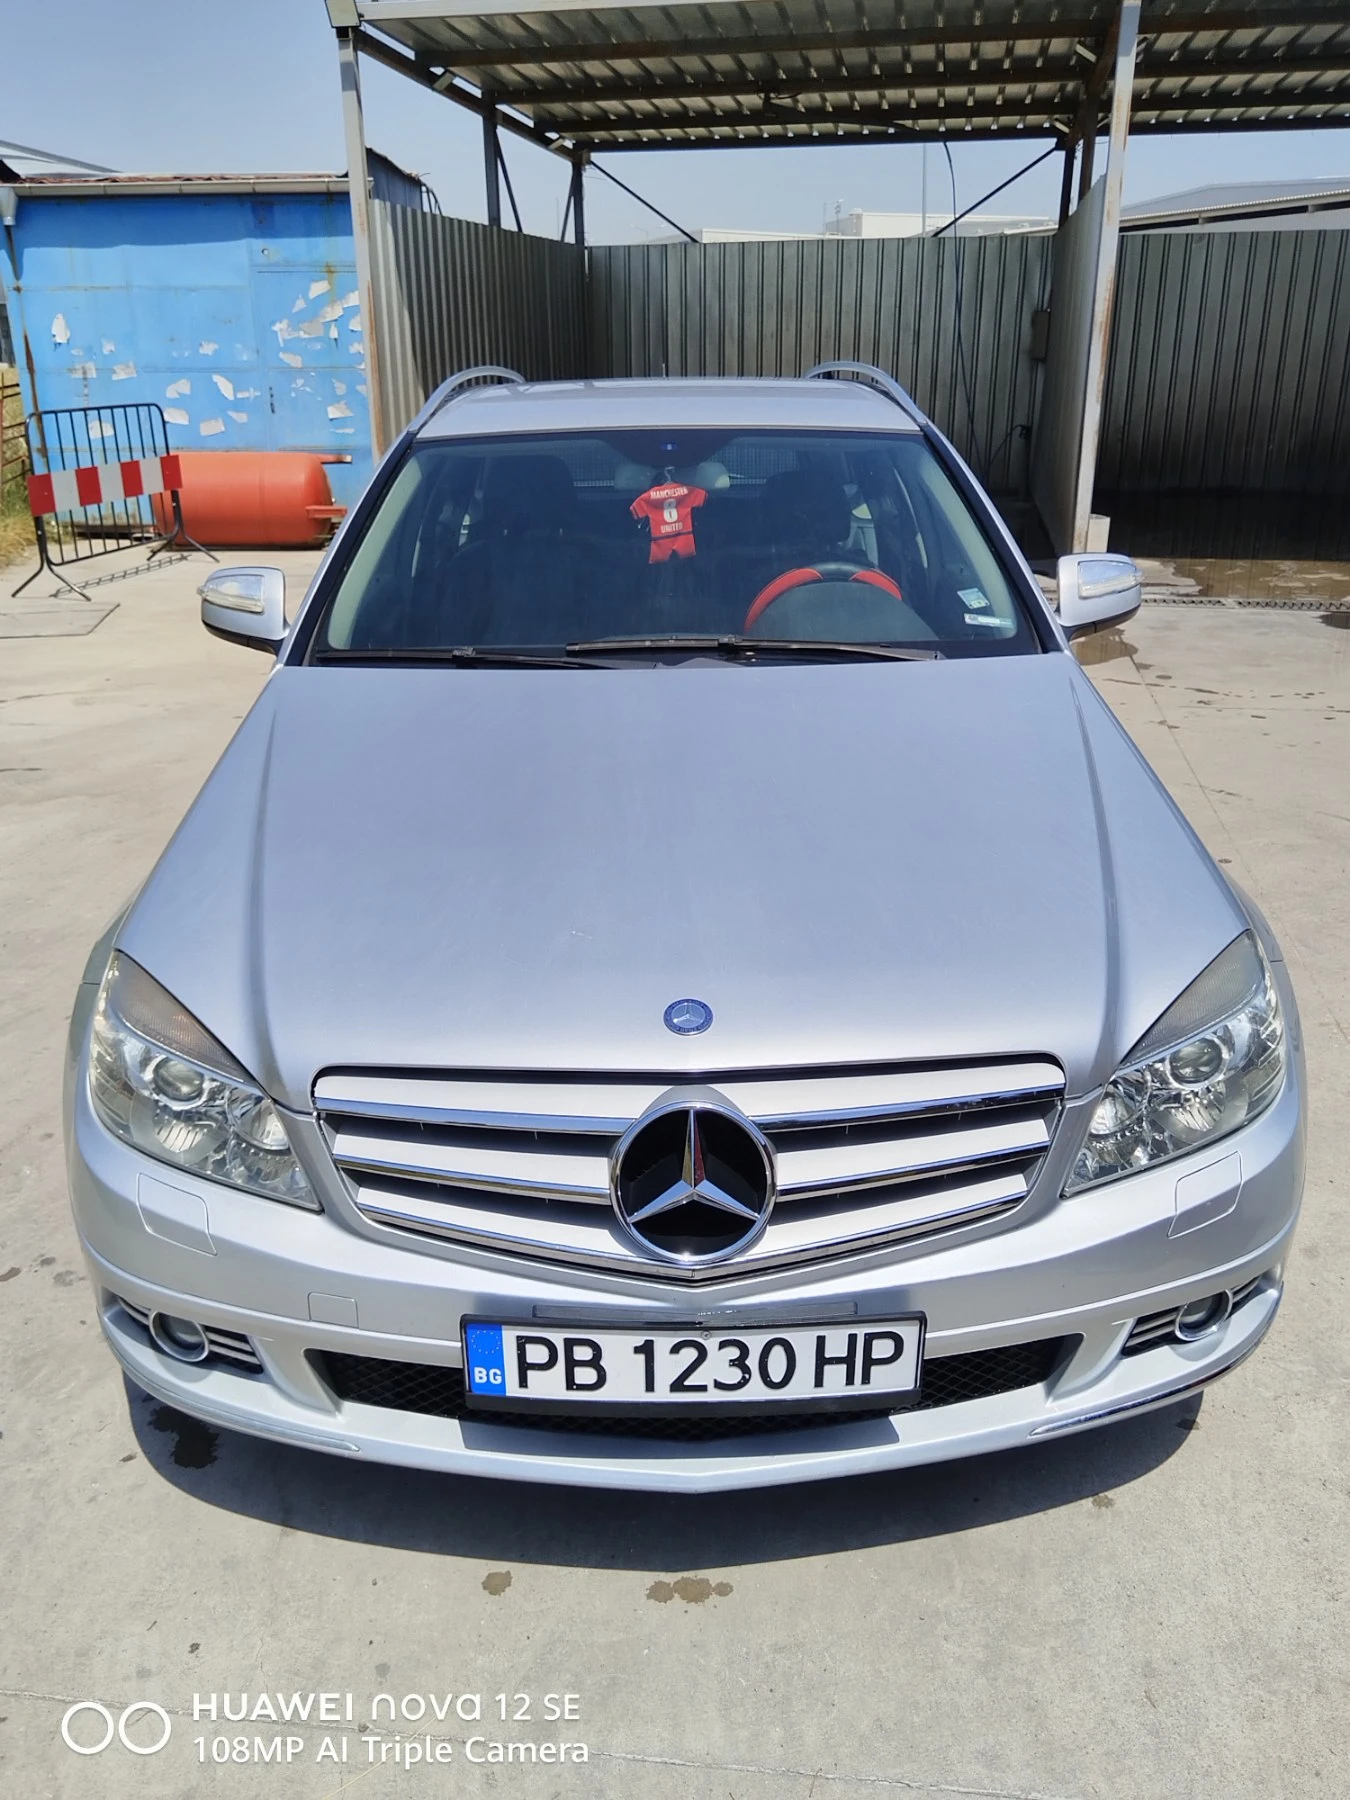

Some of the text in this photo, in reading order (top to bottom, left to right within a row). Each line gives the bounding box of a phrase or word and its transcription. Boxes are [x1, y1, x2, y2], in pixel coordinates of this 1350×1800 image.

[660, 522, 683, 533] UNITED
[515, 1331, 905, 1393] PB 1230 HP
[474, 1367, 502, 1384] BG
